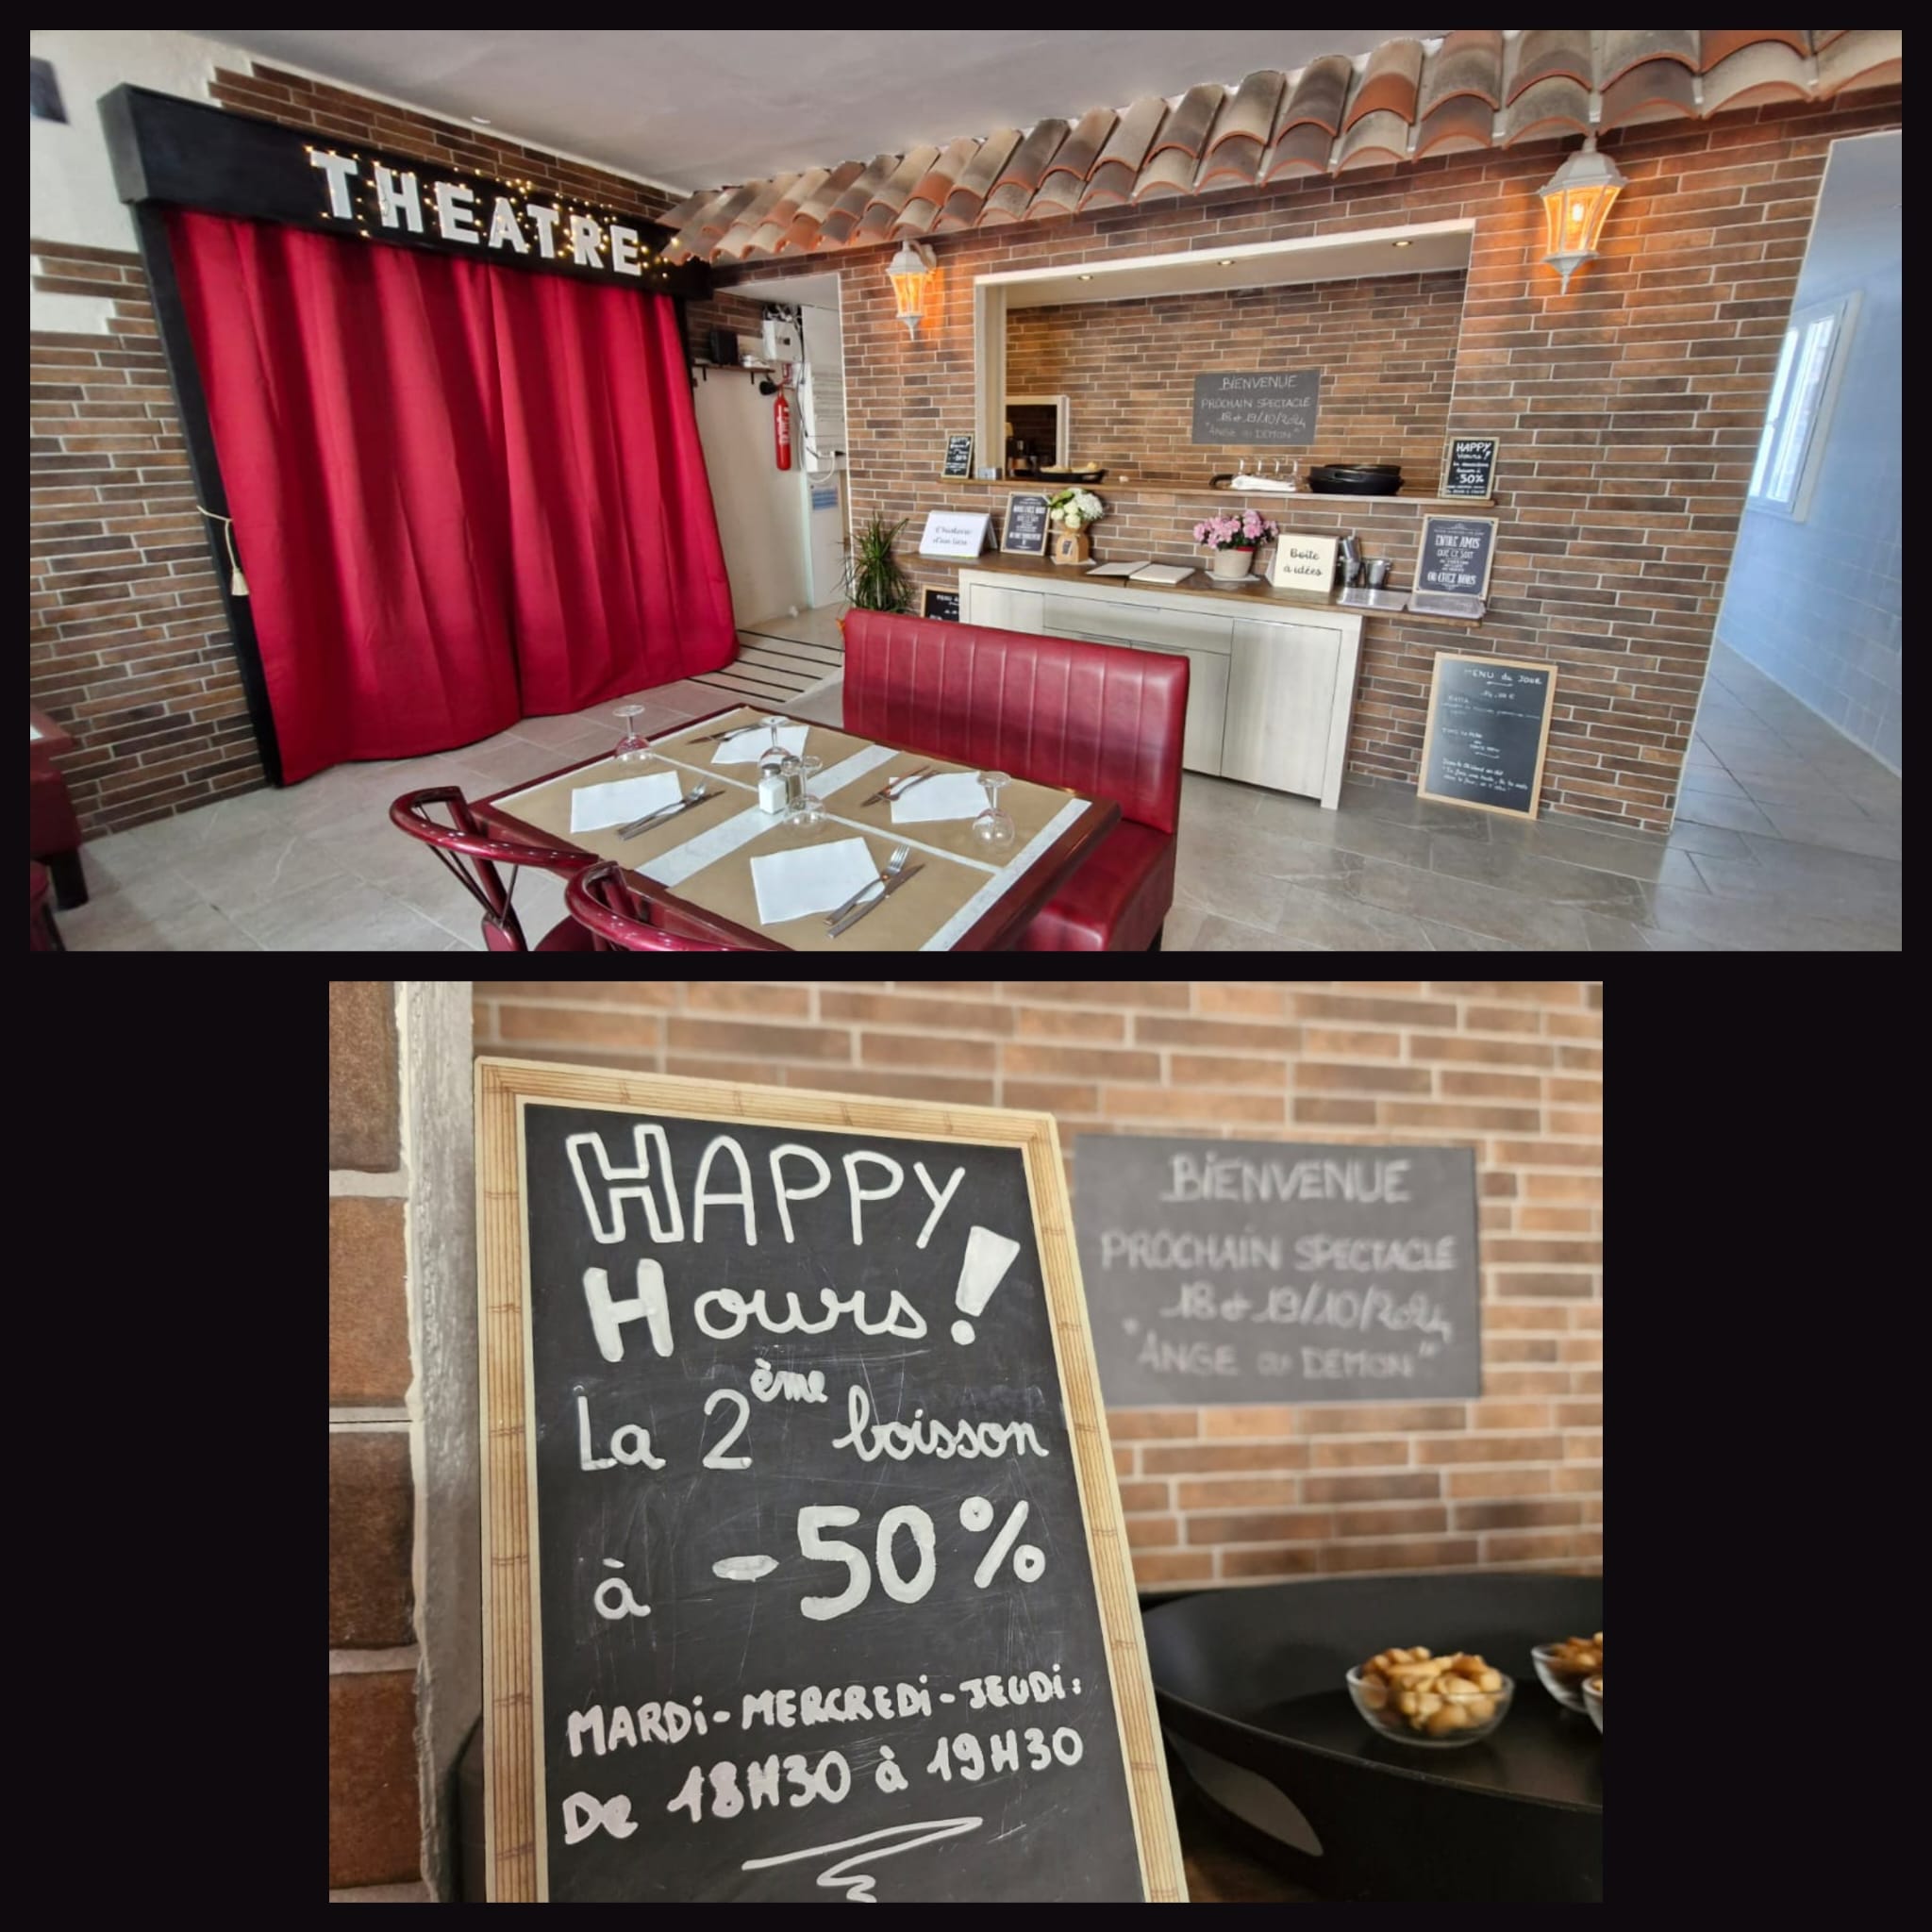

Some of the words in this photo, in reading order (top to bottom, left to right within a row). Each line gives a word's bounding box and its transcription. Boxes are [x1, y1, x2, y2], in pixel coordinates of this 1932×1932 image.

[309, 149, 642, 276] THEATRE
[1456, 442, 1491, 452] HAPPY
[1459, 536, 1481, 549] AMIS
[566, 1124, 965, 1249] HAPPY
[1294, 1233, 1459, 1273] SPECTACLE
[574, 1394, 665, 1471] La
[832, 1385, 1049, 1462] boisson
[593, 1557, 652, 1621] à
[562, 1791, 639, 1845] De
[667, 1751, 851, 1823] 18H30
[874, 1745, 908, 1792] à
[926, 1727, 1084, 1781] 19H30
